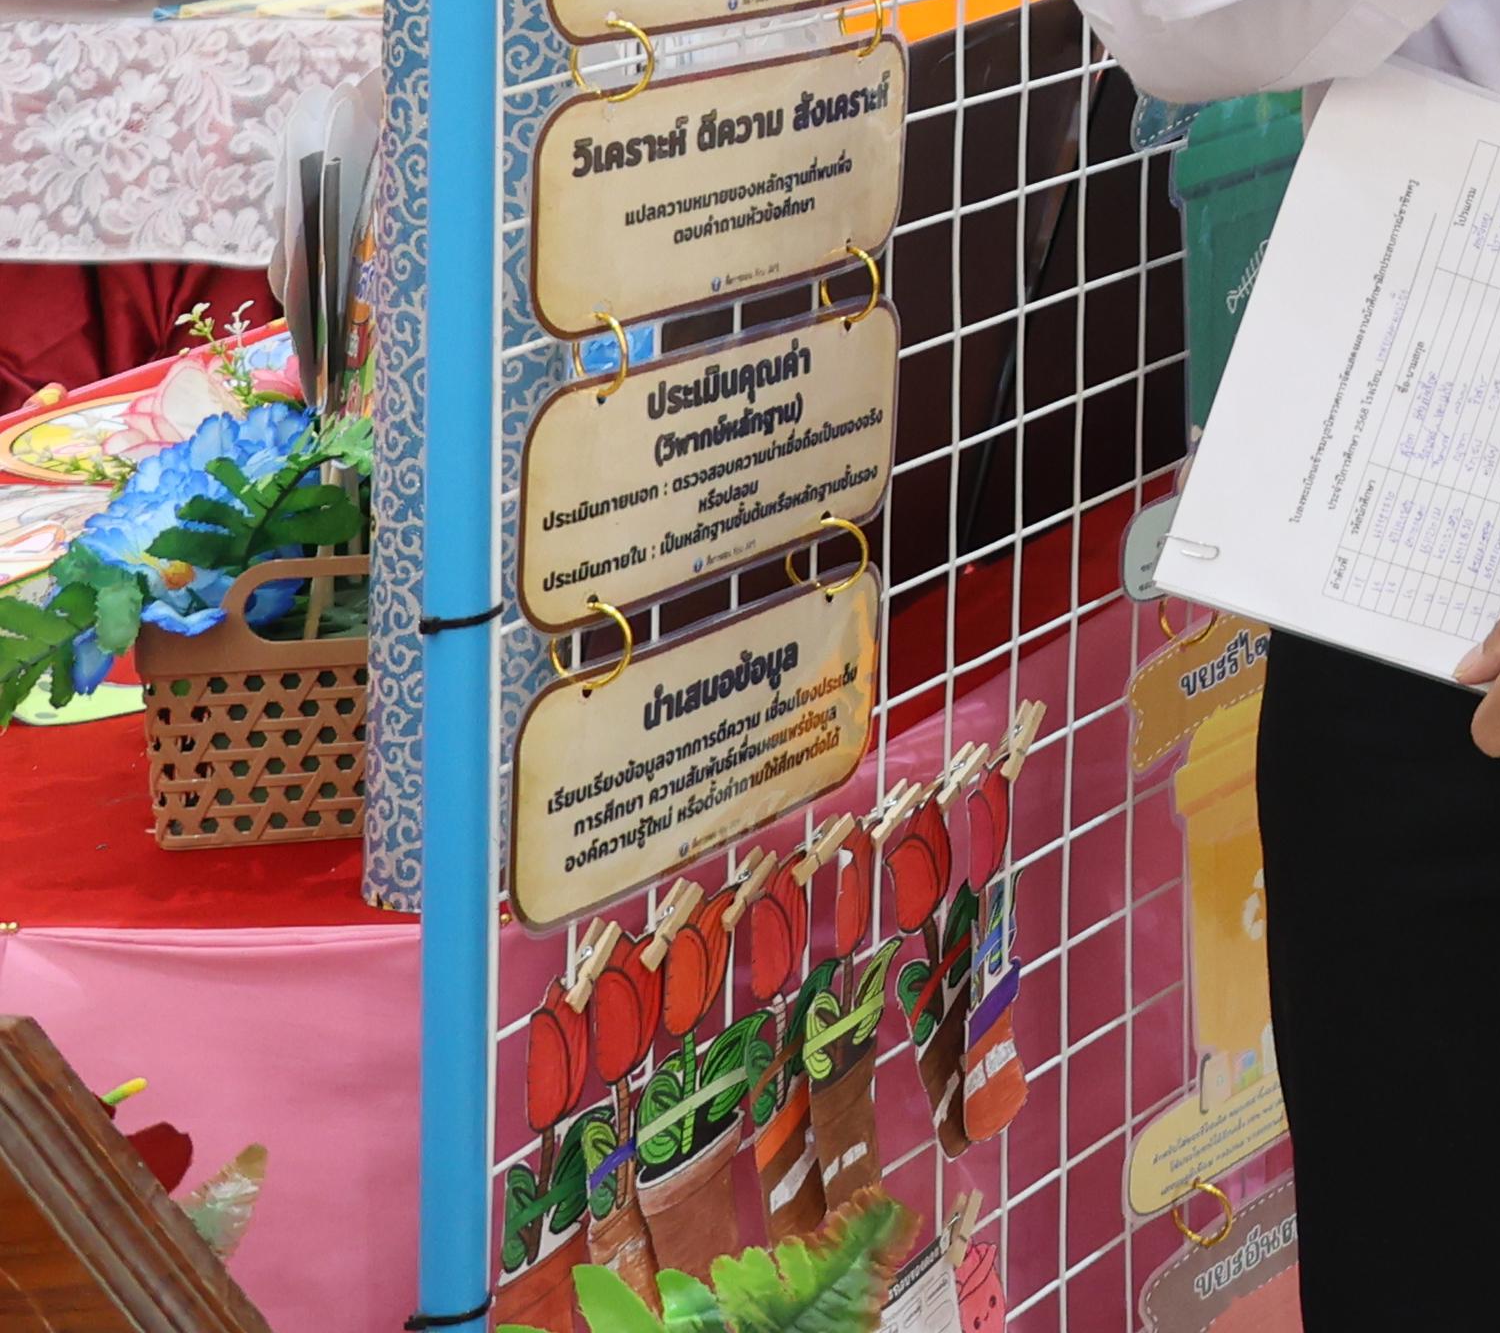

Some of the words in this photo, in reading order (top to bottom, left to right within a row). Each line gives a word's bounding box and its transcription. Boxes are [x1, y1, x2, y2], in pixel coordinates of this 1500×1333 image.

[572, 115, 688, 178] วิเคราะห์
[696, 105, 784, 154] ตีความ
[673, 194, 816, 245] ตอบคำถามหัวข้อศึกษา
[647, 338, 812, 420] ประเมินคุณค่า
[1353, 406, 1369, 432] 2568
[542, 483, 659, 532] ประเมินภายนอก
[698, 480, 760, 514] หรือปลอม
[542, 540, 647, 593] ประเมินภายใน
[643, 640, 800, 731] นำเสนอข้อมูล
[563, 807, 674, 874] องค์ความรู้ใหม่
[573, 792, 644, 837] การศึกษา
[1194, 1213, 1298, 1300] ขยะอันต
